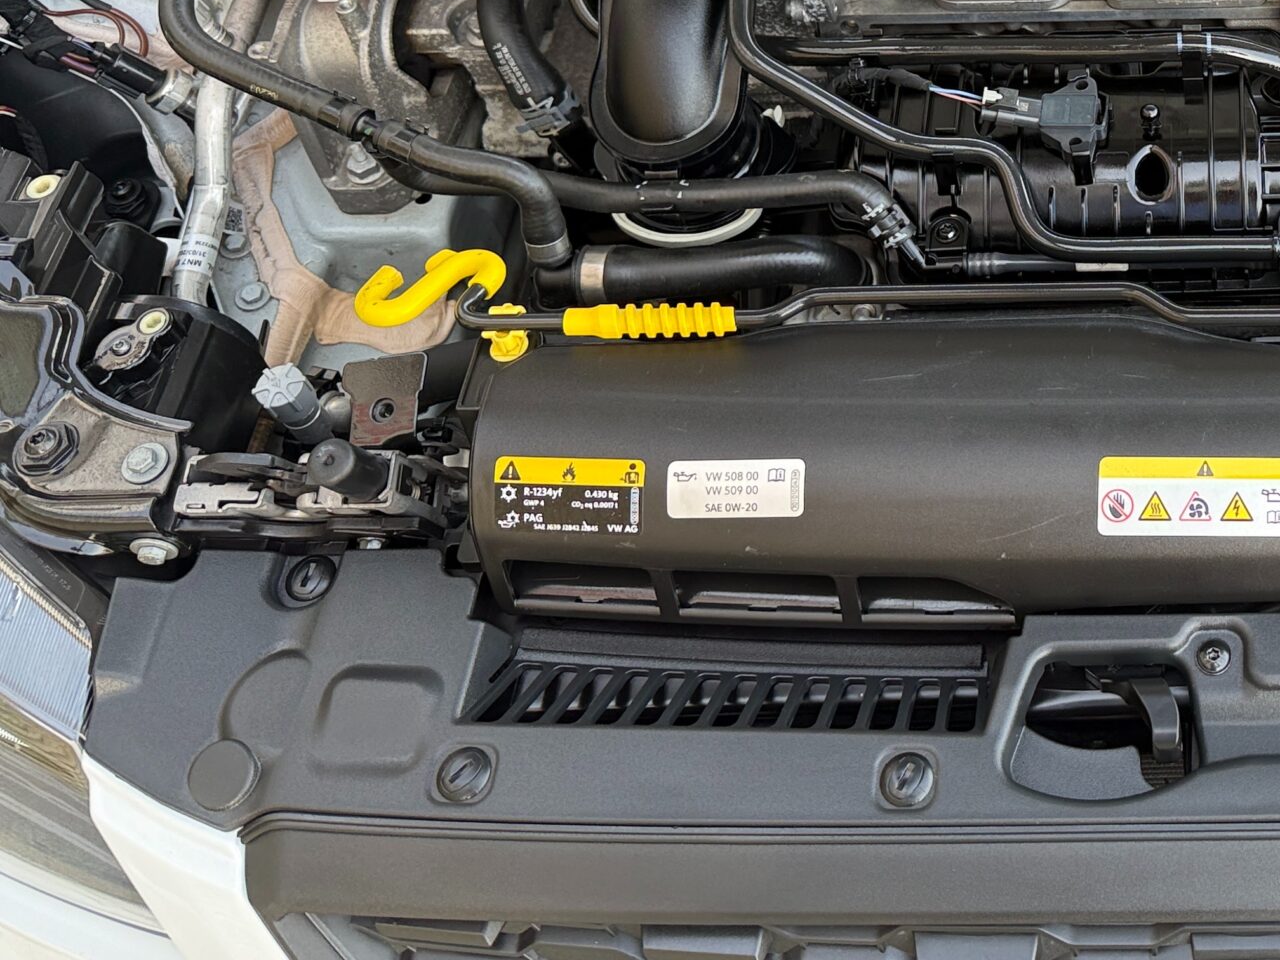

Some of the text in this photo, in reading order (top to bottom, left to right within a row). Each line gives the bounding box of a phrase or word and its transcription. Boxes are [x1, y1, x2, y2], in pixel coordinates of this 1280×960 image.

[705, 472, 759, 482] VW 508 00
[523, 487, 619, 501] R-1234yf 0.430 kg
[705, 485, 759, 495] VW 509 00
[705, 502, 758, 512] SAE 0W-20
[523, 513, 543, 522] PAG
[624, 525, 638, 533] AG
